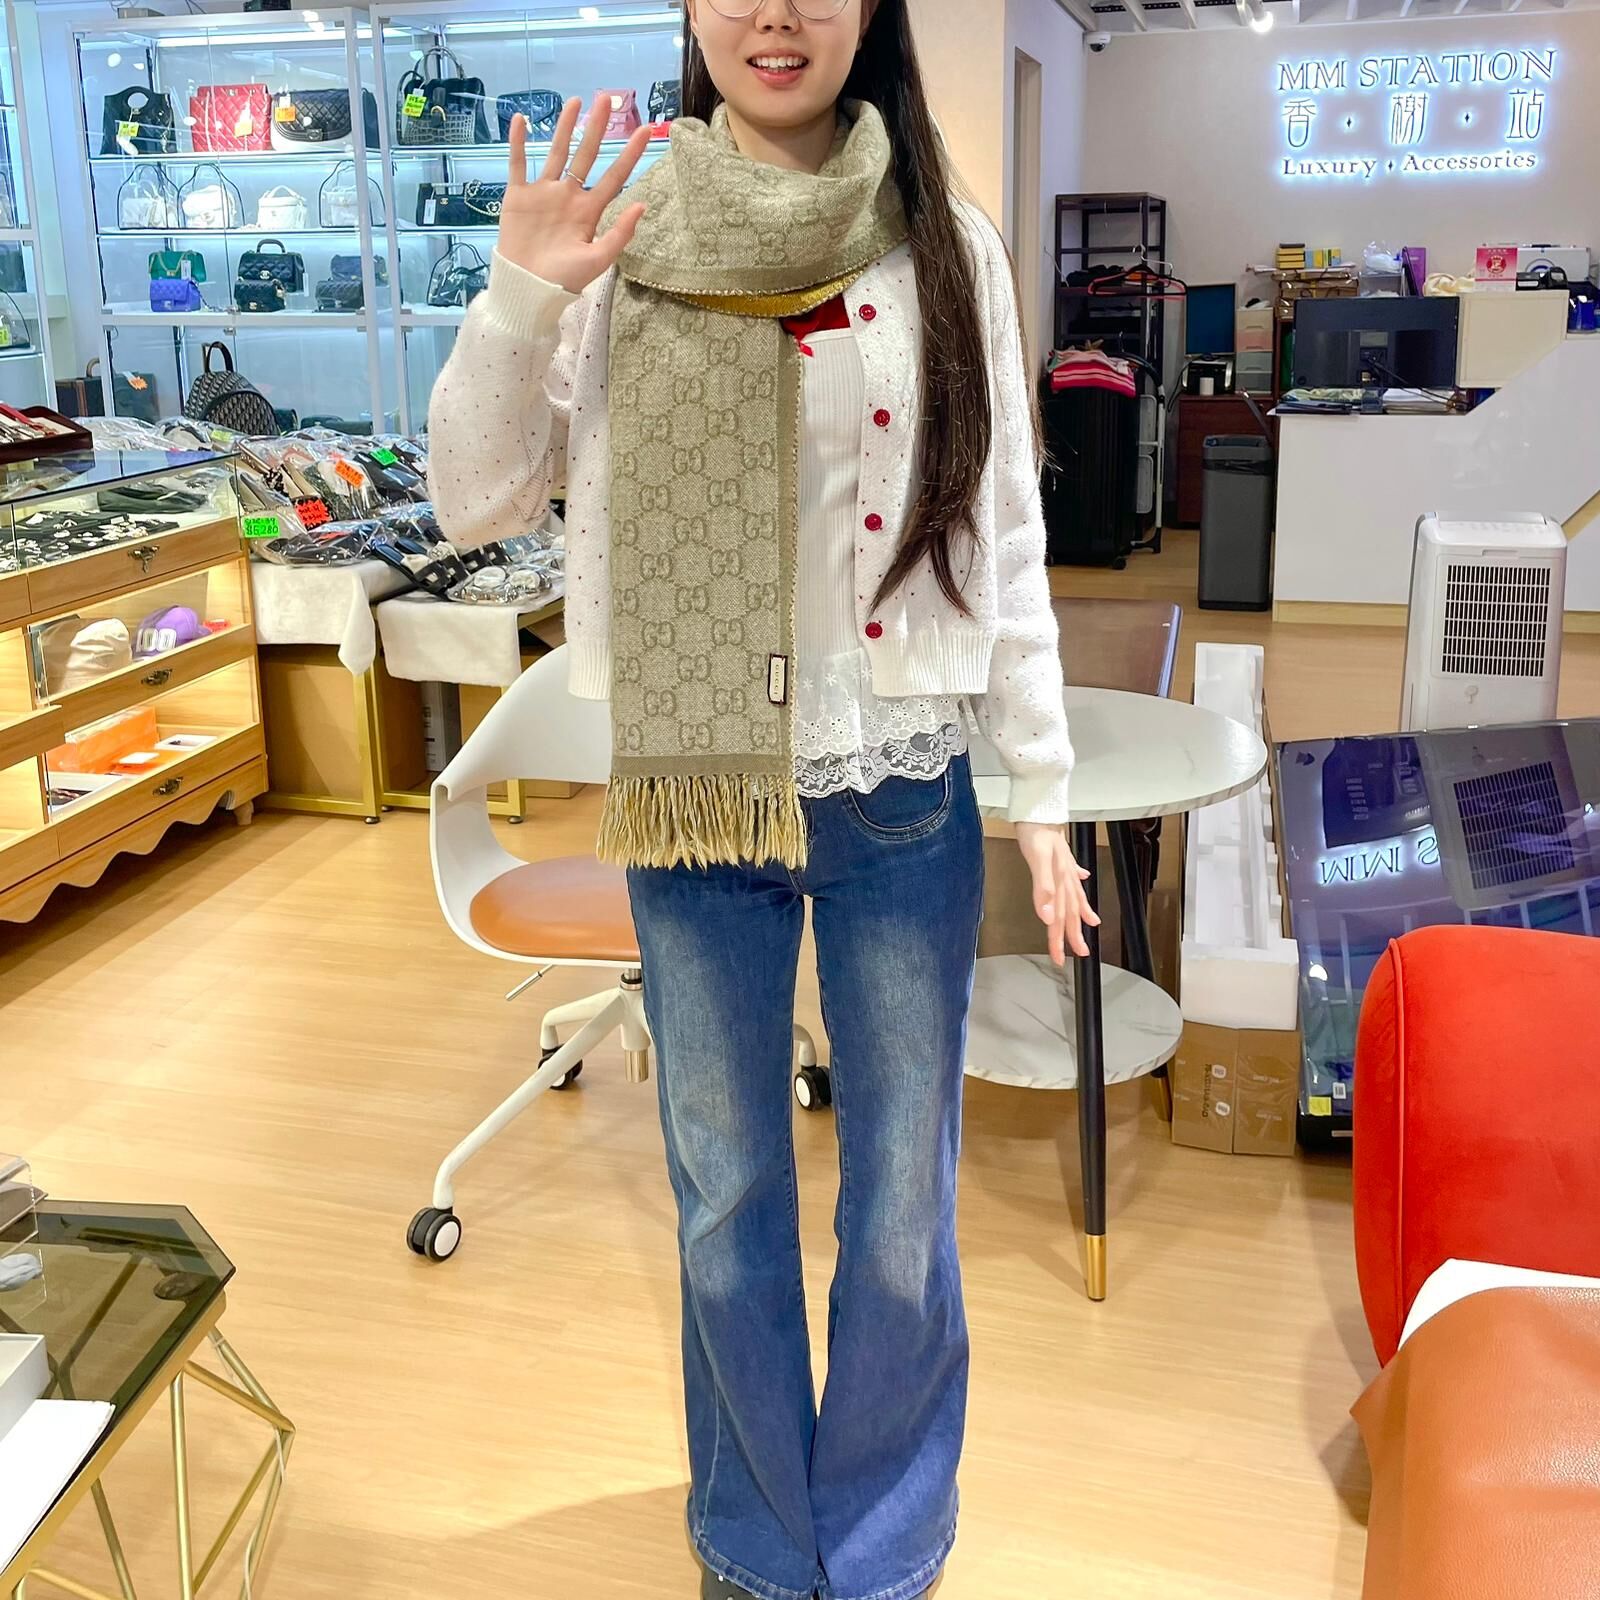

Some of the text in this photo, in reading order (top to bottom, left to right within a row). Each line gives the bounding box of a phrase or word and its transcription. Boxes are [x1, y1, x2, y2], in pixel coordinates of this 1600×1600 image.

[1278, 50, 1557, 91] MM STATION
[1283, 150, 1536, 178] Luxury Accessories
